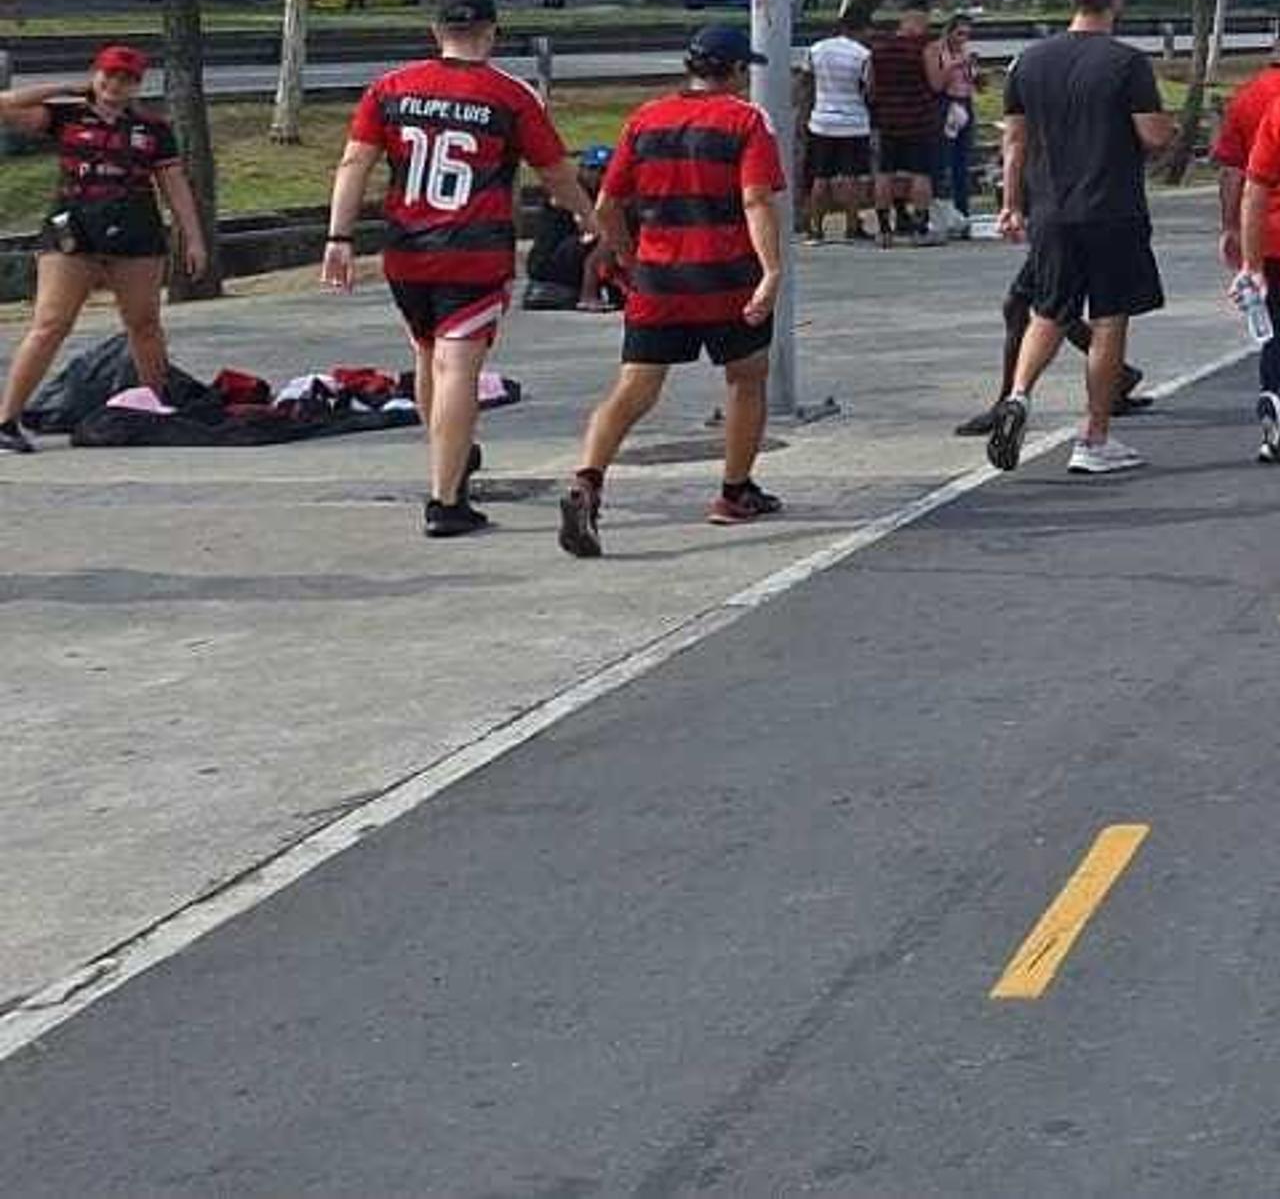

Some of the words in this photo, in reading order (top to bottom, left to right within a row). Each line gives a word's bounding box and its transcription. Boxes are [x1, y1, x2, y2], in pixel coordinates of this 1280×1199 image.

[400, 96, 451, 118] FILIPE
[454, 102, 492, 123] LUIS
[400, 125, 479, 210] 16
